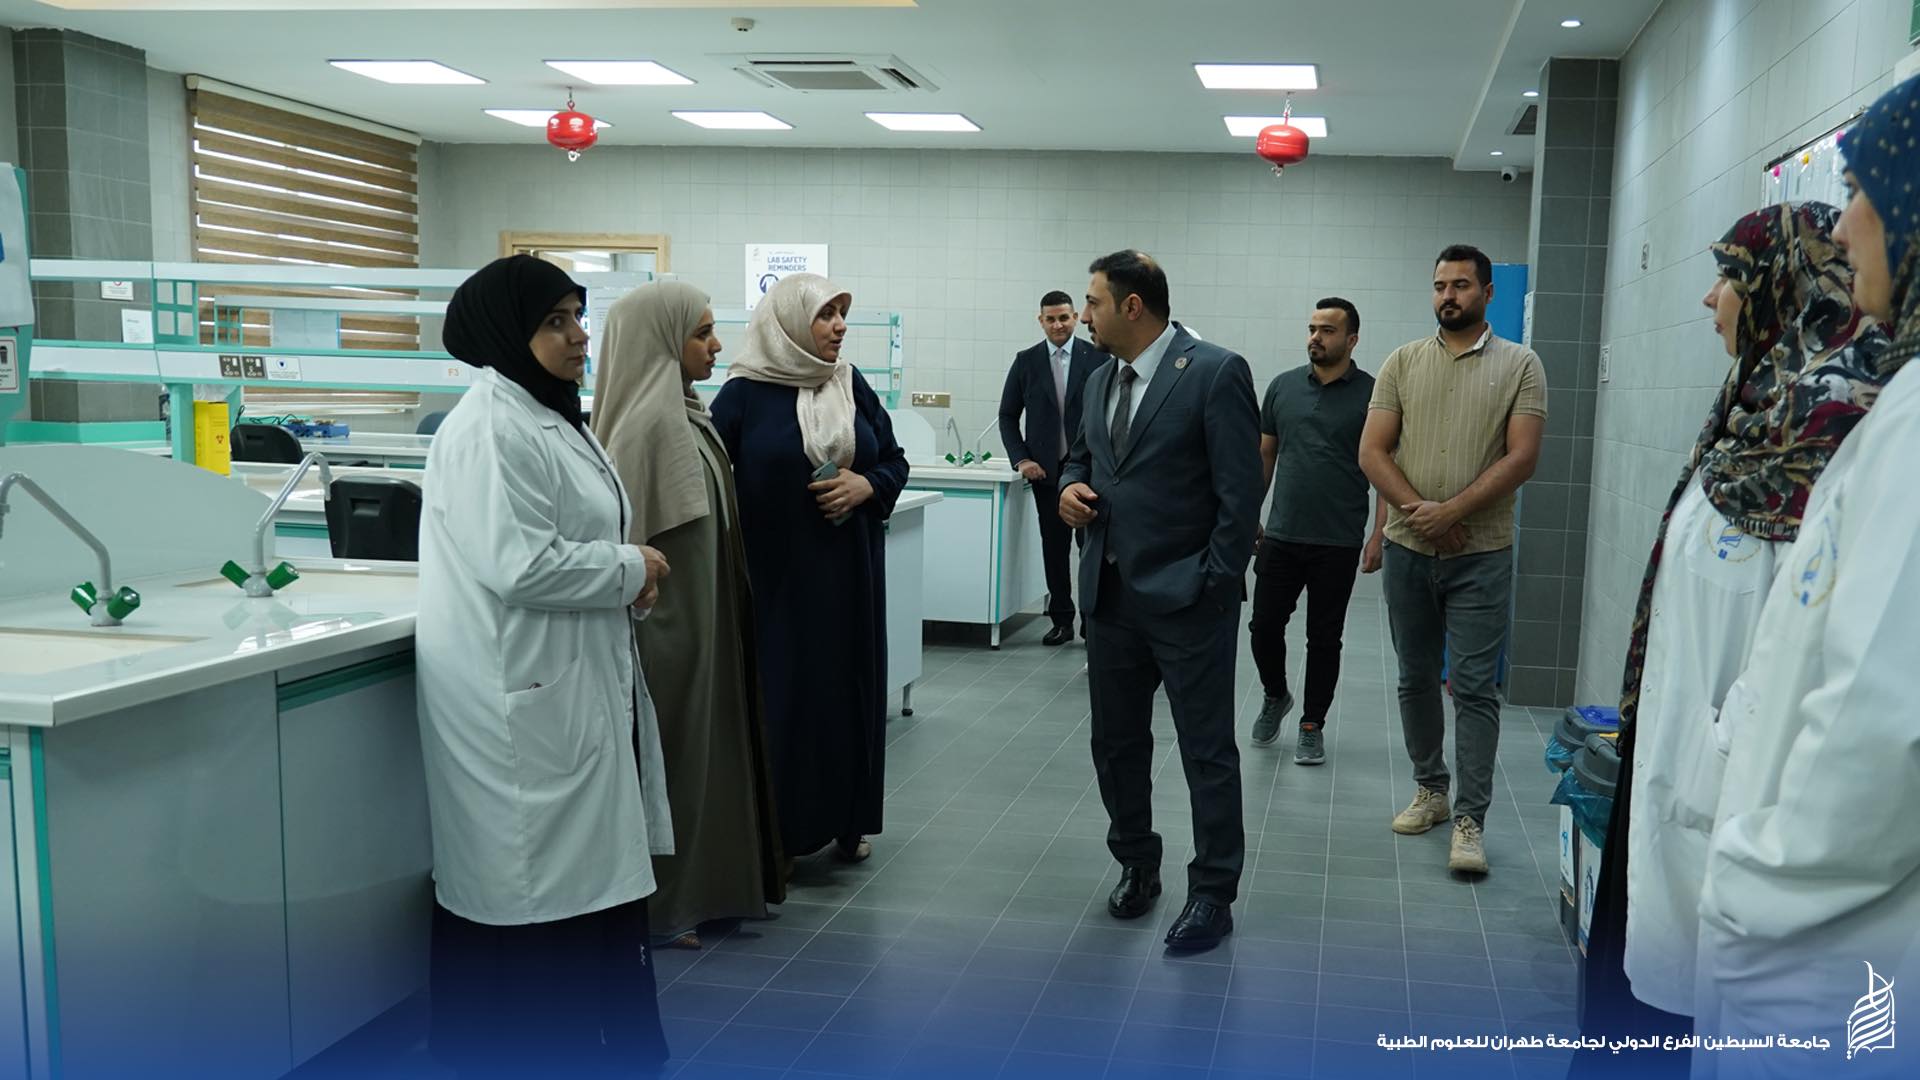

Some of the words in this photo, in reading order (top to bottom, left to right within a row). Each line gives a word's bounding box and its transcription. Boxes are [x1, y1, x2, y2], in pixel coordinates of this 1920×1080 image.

[767, 256, 780, 264] LAB
[781, 256, 807, 264] SAFETY
[768, 264, 807, 272] REMINDERS
